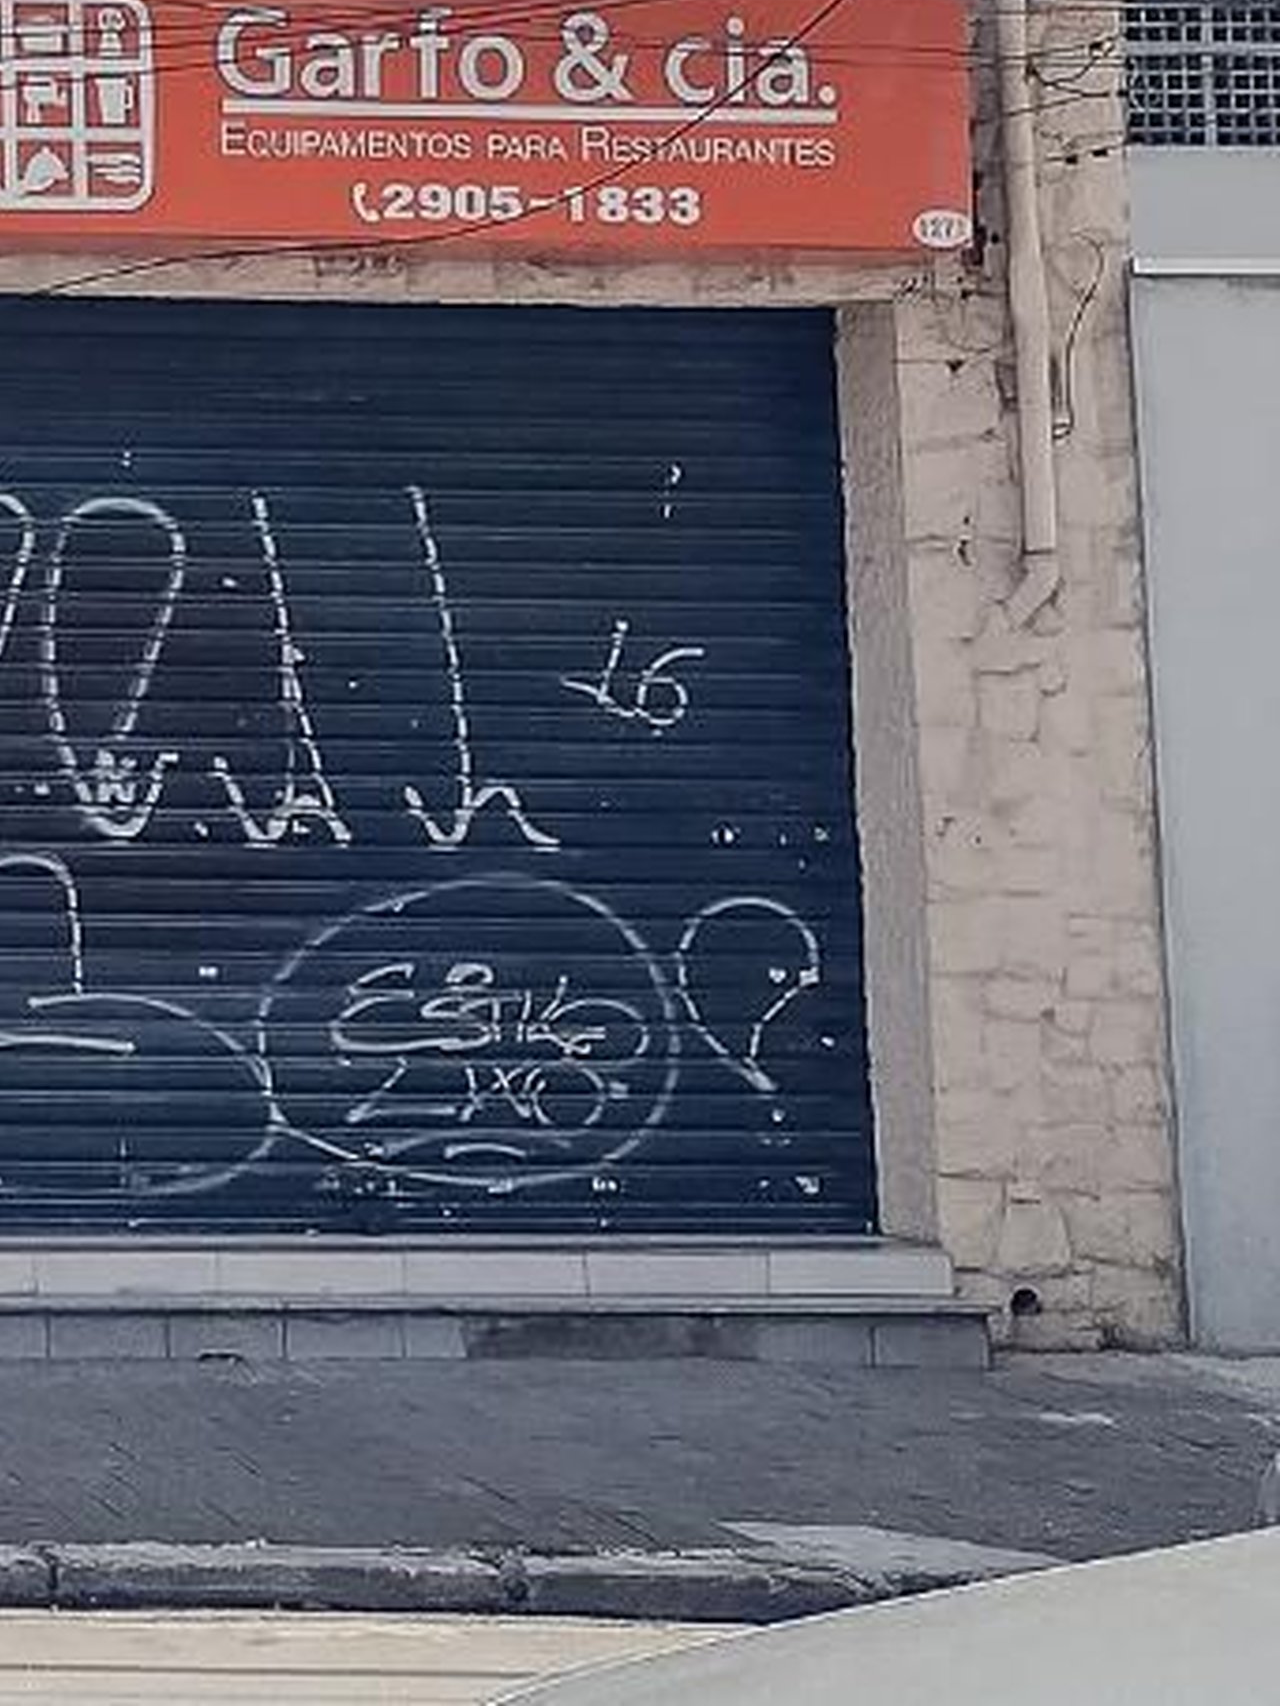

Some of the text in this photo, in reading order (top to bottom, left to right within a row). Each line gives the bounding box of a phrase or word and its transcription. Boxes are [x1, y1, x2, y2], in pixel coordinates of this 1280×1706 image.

[216, 6, 526, 100] Garfo
[553, 11, 634, 103] &
[381, 183, 702, 224] 2905-1833
